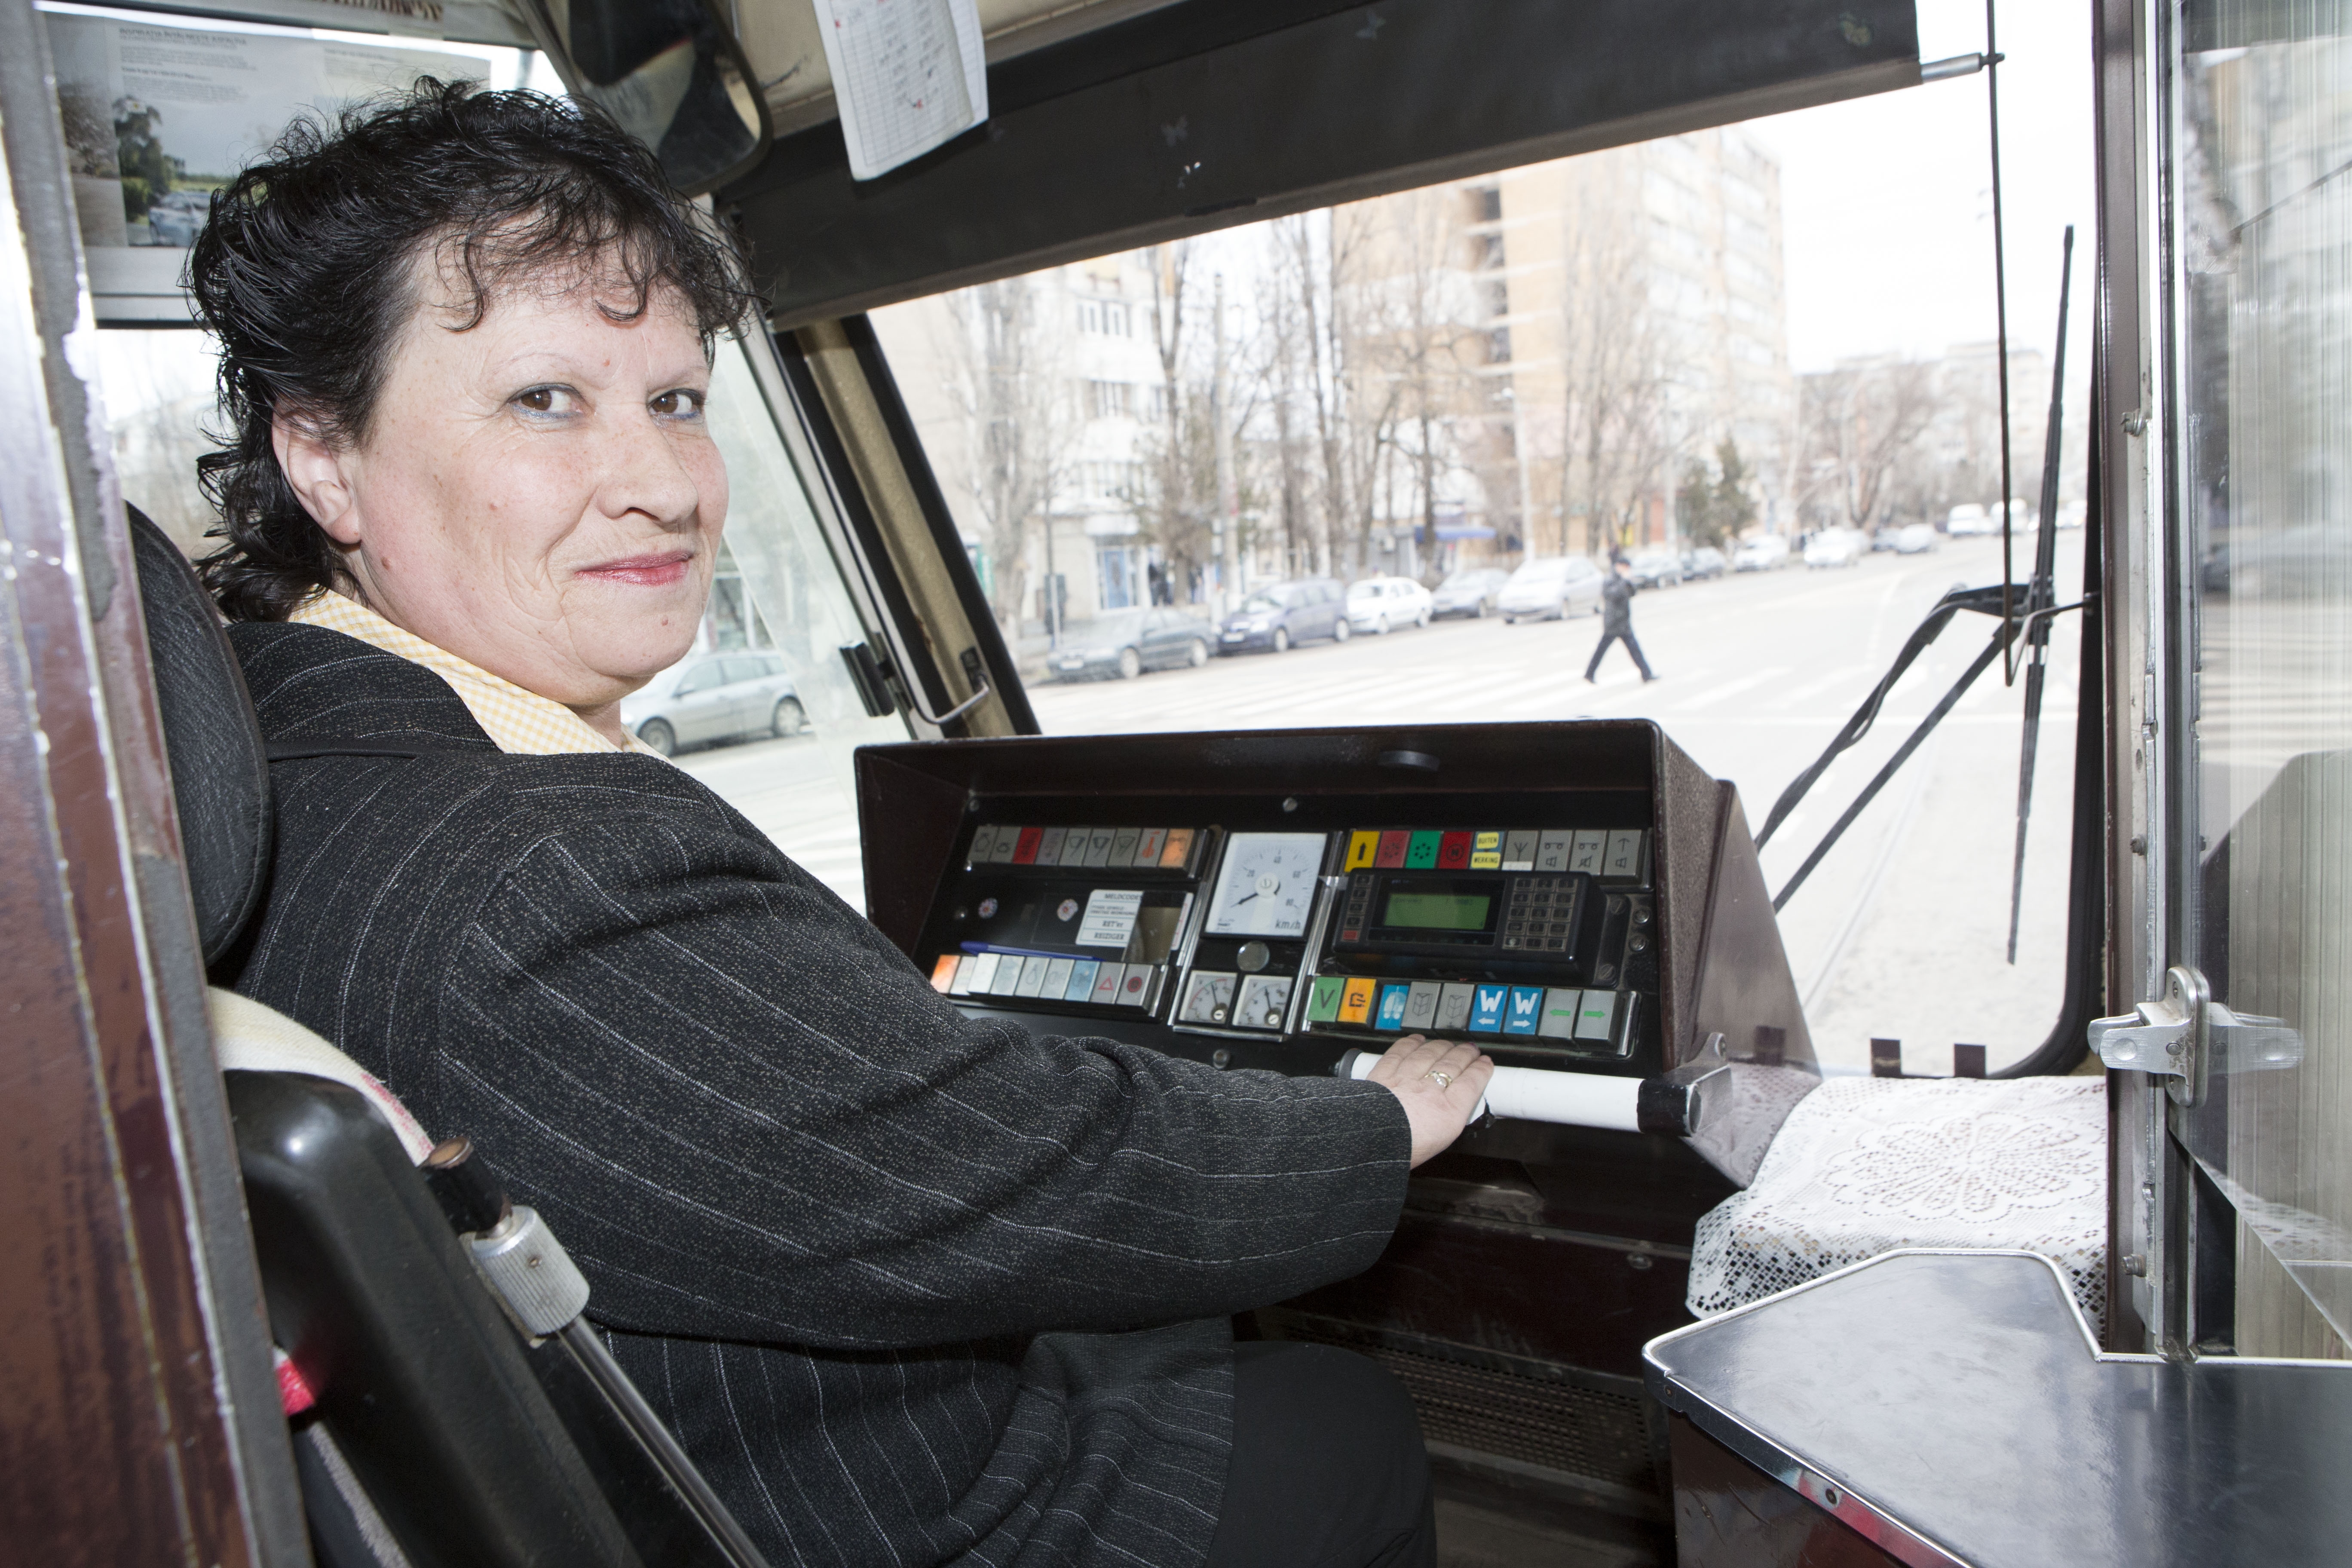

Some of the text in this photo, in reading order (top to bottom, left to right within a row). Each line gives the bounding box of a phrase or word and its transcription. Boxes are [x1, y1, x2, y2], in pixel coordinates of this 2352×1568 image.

[1274, 919, 1301, 929] km/h
[1320, 989, 1335, 1009] V
[1480, 989, 1504, 1012] W
[1514, 992, 1538, 1015] W
